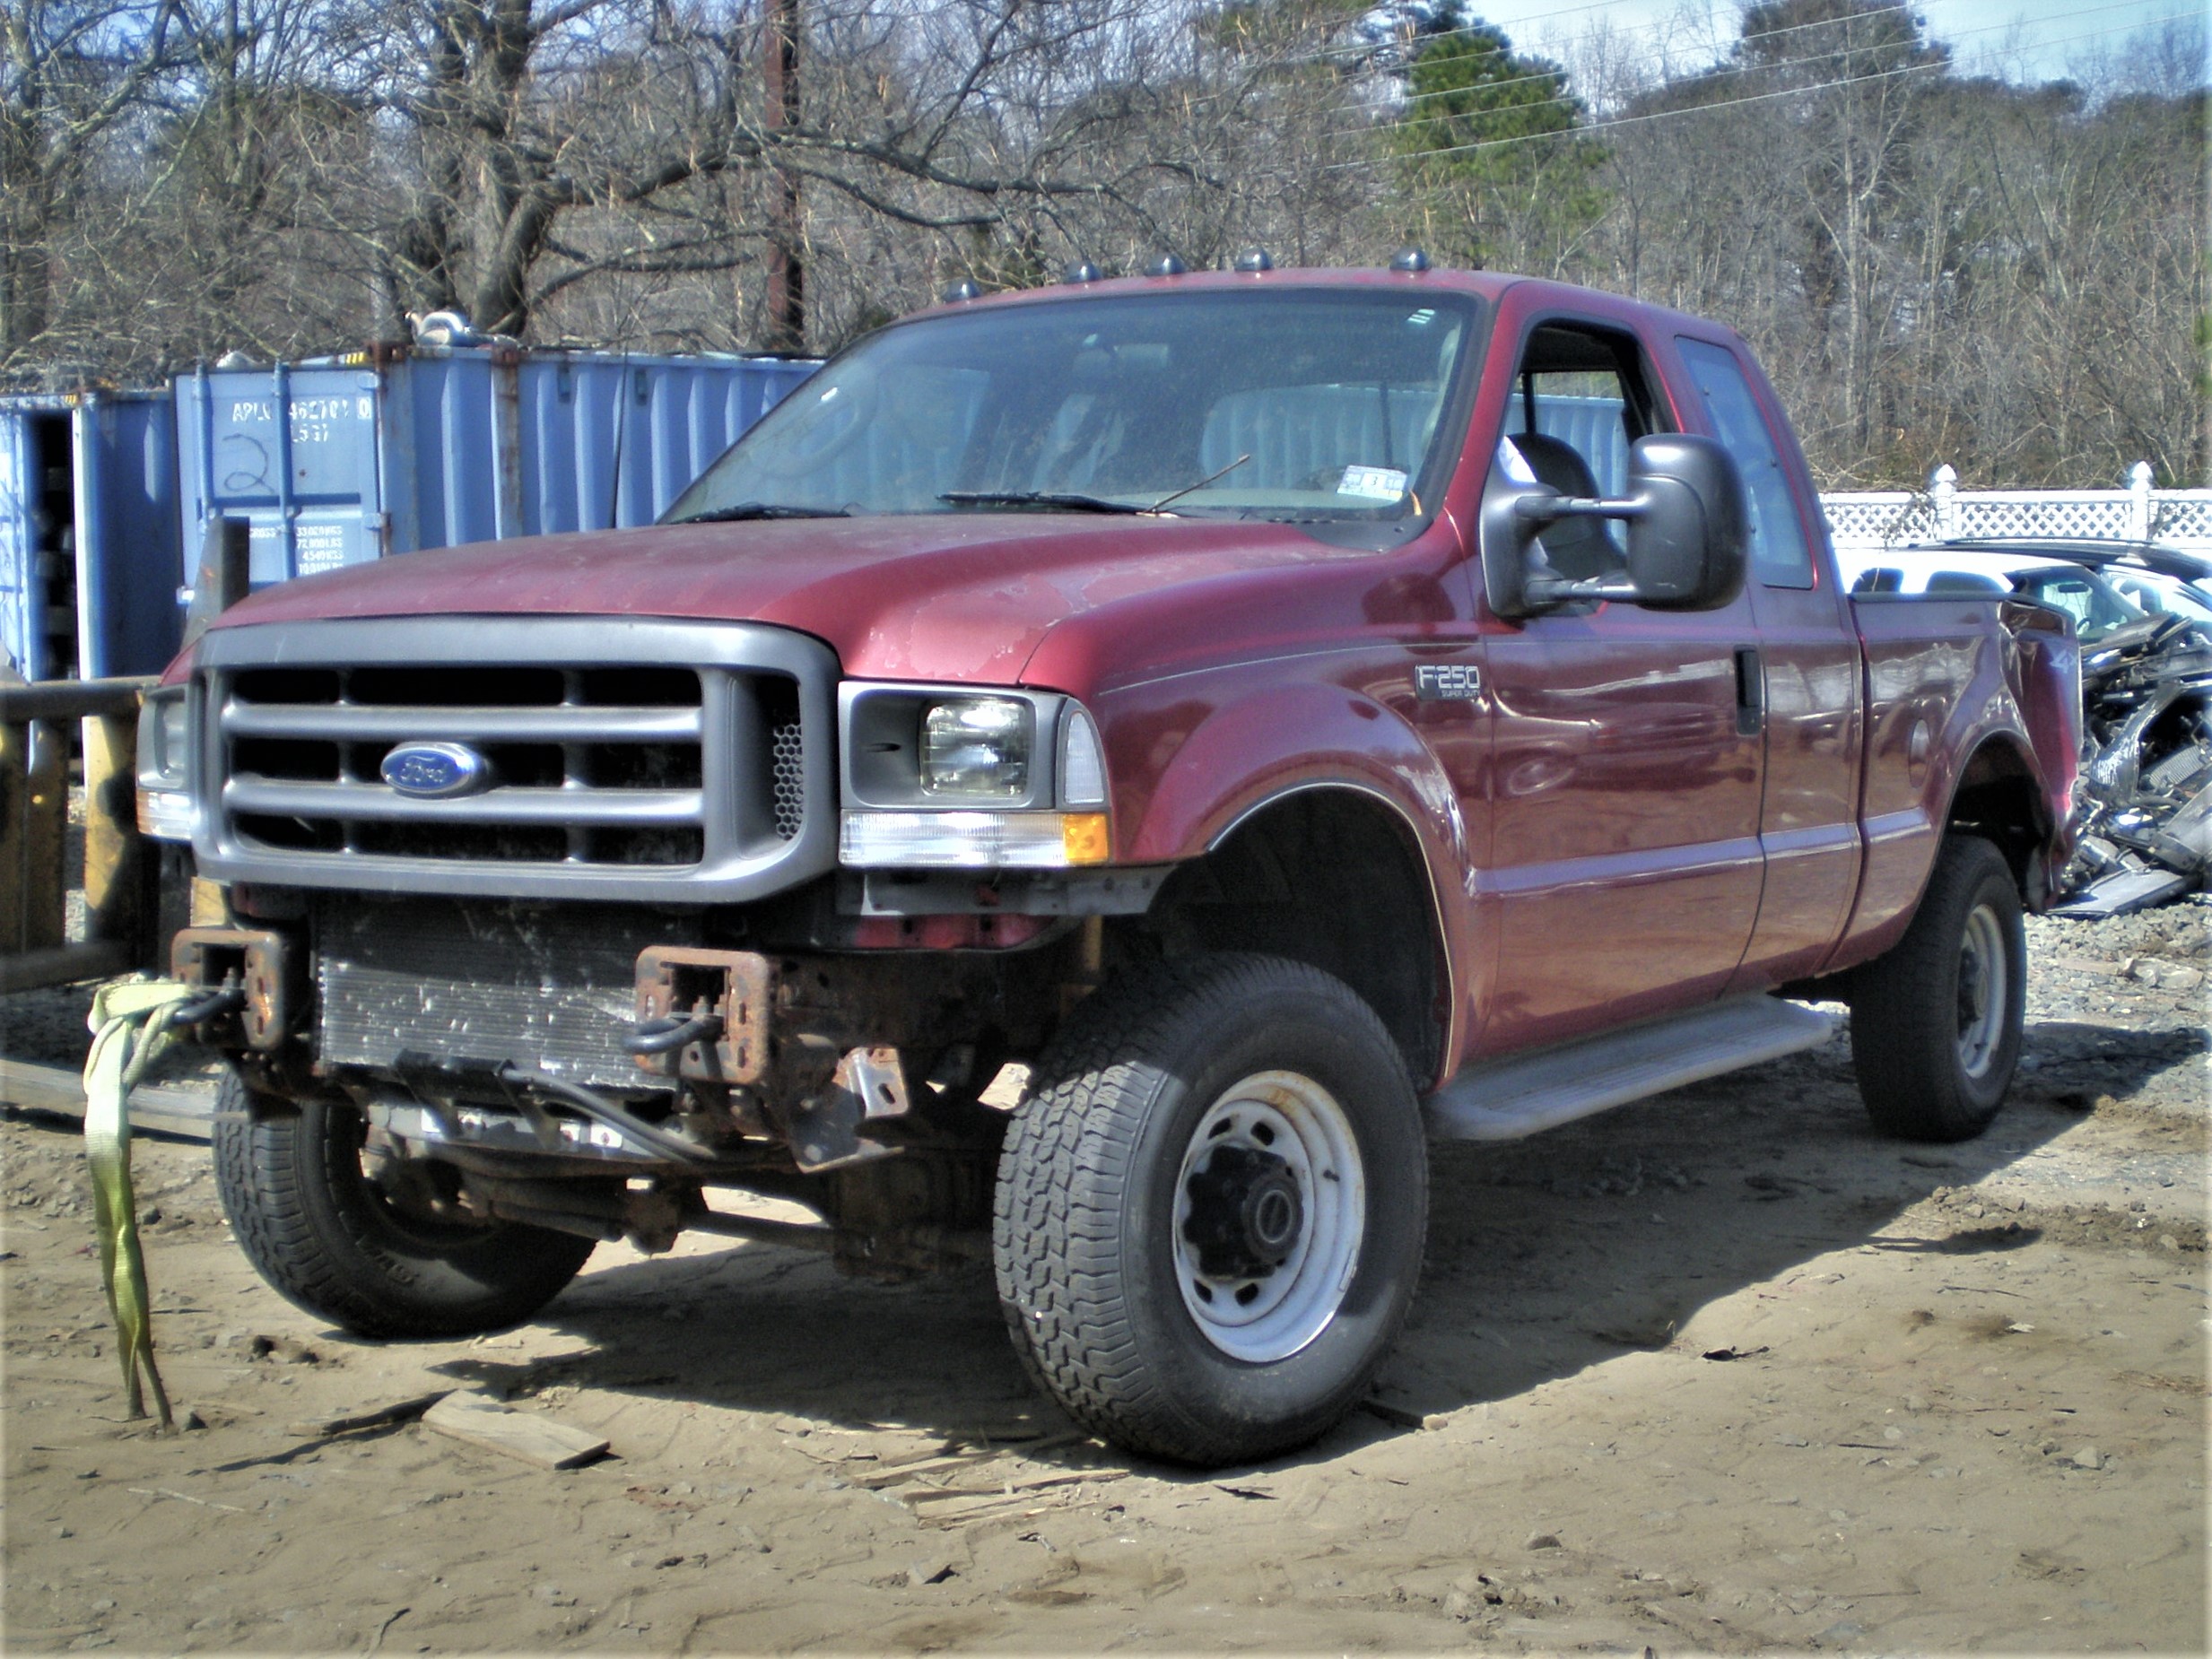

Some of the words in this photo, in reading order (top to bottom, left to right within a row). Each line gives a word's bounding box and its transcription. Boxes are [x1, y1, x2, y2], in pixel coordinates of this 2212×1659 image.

[222, 432, 276, 493] 2
[1441, 689, 1463, 698] SUPER
[1464, 689, 1481, 698] DUTY
